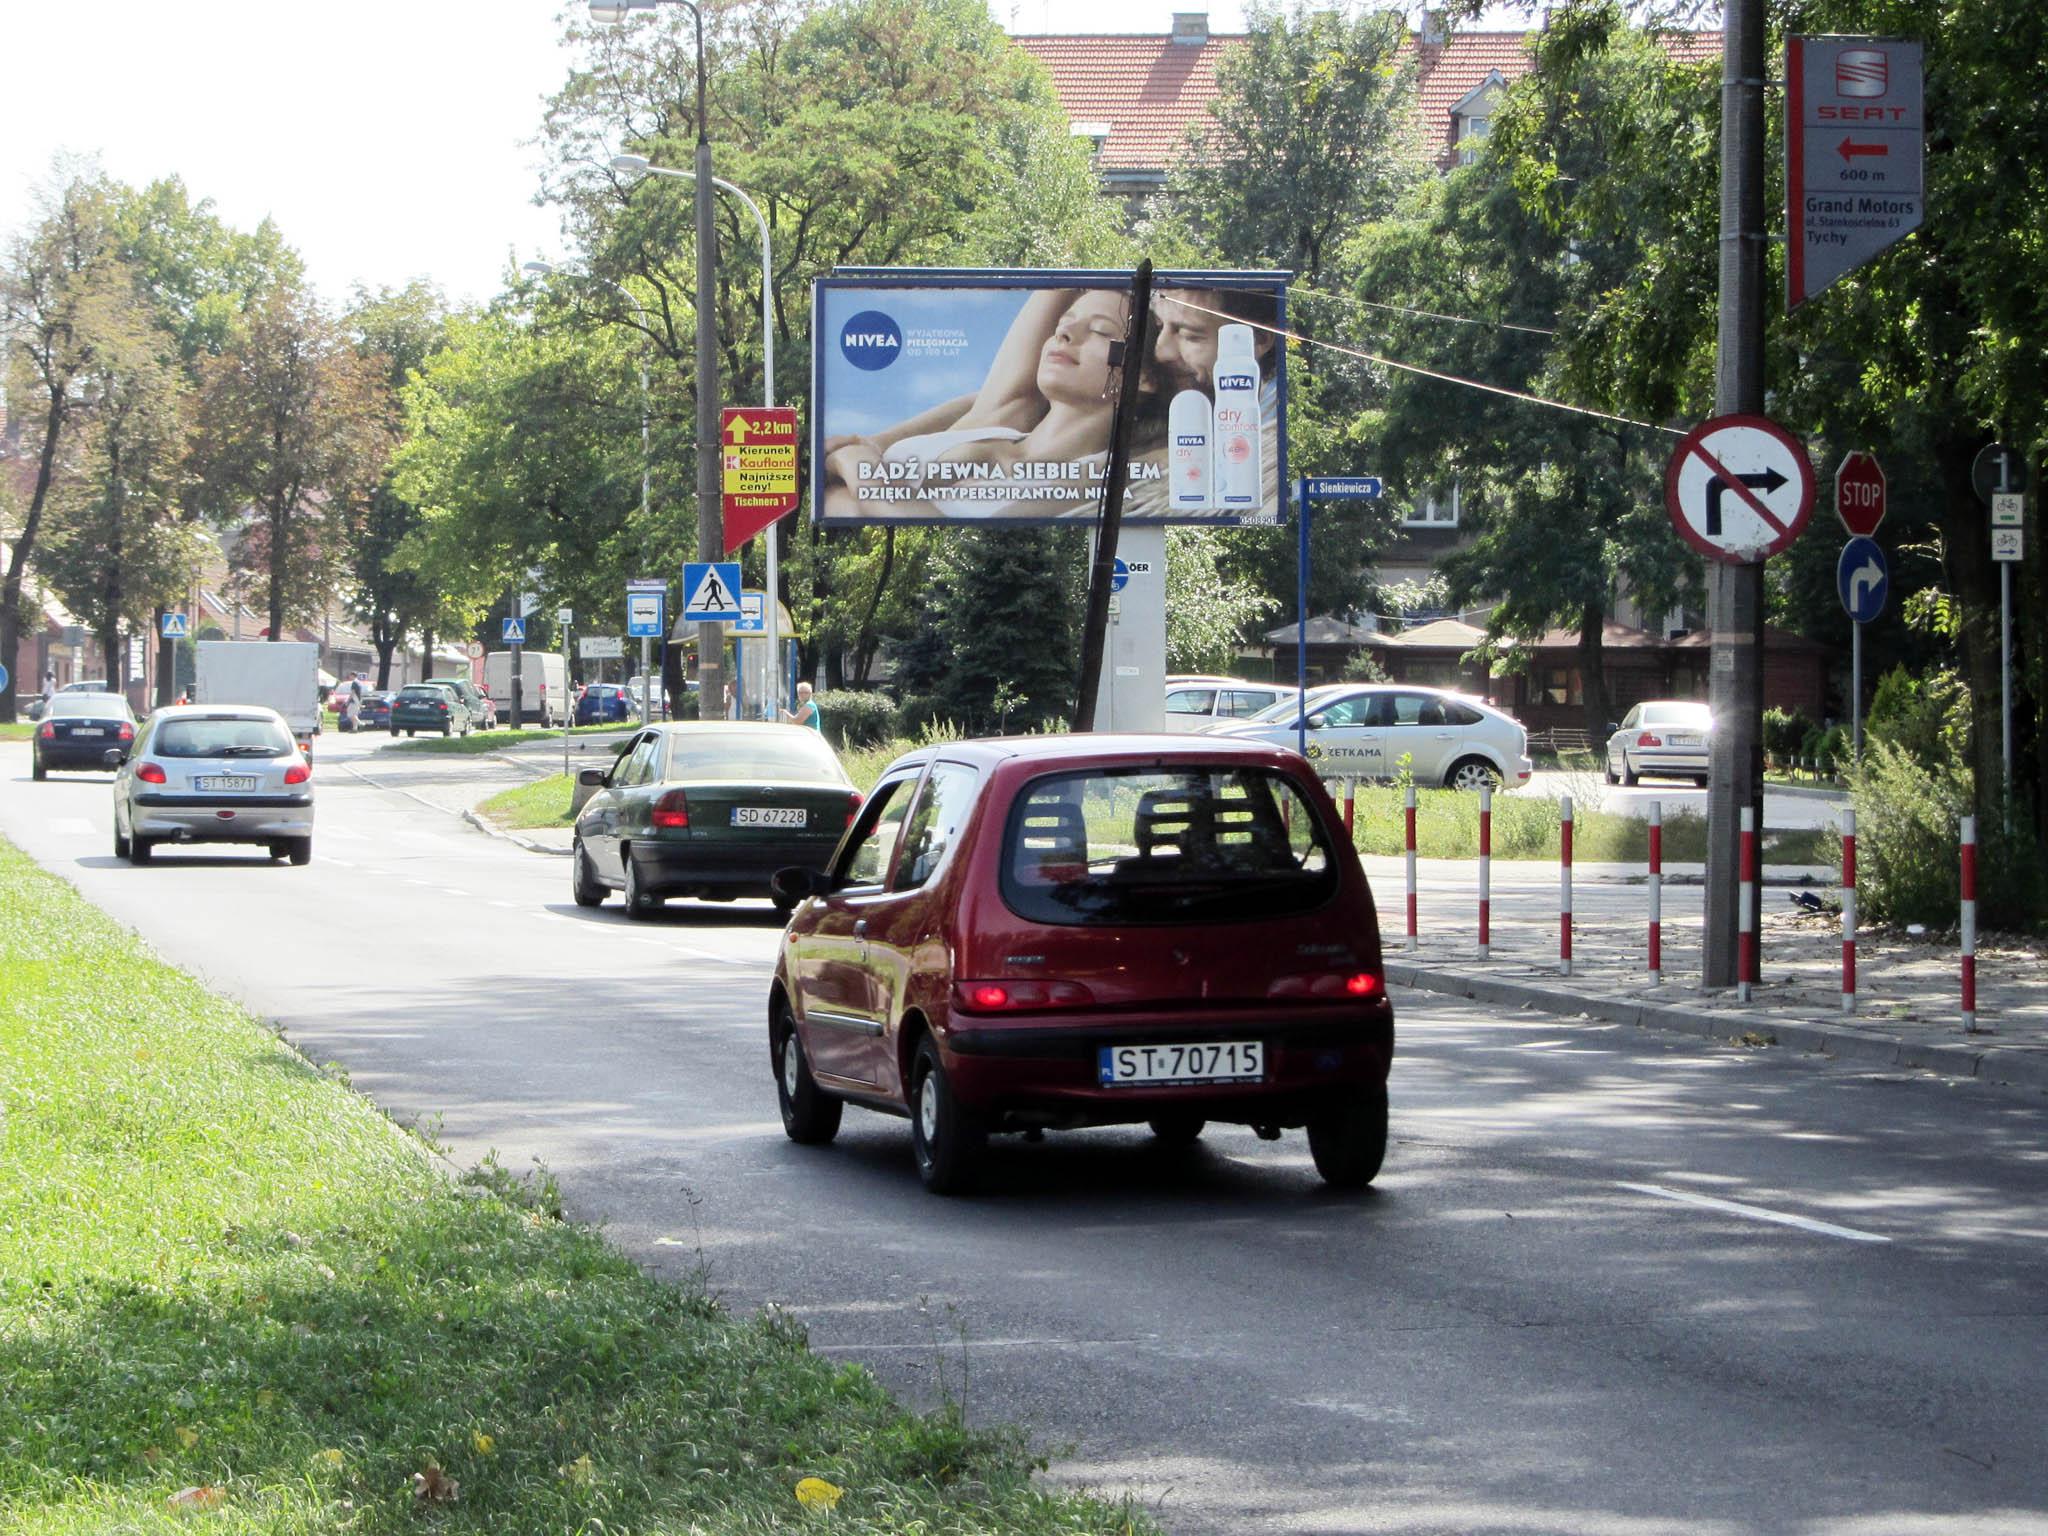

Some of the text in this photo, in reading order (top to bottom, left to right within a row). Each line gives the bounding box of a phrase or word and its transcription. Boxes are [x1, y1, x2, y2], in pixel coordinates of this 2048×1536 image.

[1817, 106, 1906, 120] SEAT
[1839, 169, 1885, 181] 600 m
[1806, 198, 1914, 214] Grand Motors
[1807, 230, 1847, 246] Tychy
[845, 333, 898, 347] NIVEA
[1220, 379, 1252, 388] NIVEA
[1218, 407, 1242, 423] dry
[752, 421, 792, 436] 2,2 km
[739, 447, 791, 455] Kierunek
[739, 457, 794, 468] Kaufland
[739, 473, 794, 482] Najniższe
[859, 457, 1161, 484] BĄDŹ PEWNA SIEBIE LEM
[740, 483, 771, 492] ceny!
[859, 486, 1133, 503] DZIĘKI ANTYPERSPIRANTOM NIA
[1319, 482, 1371, 494] Sienkiewicza
[1843, 481, 1881, 507] STOP
[735, 497, 787, 506] Tischnera 1
[1328, 748, 1381, 758] ZETKAMA
[202, 777, 252, 788] ST 15871
[739, 809, 804, 823] SD 67228
[1118, 1048, 1157, 1077] ST
[1170, 1044, 1258, 1076] 70715
